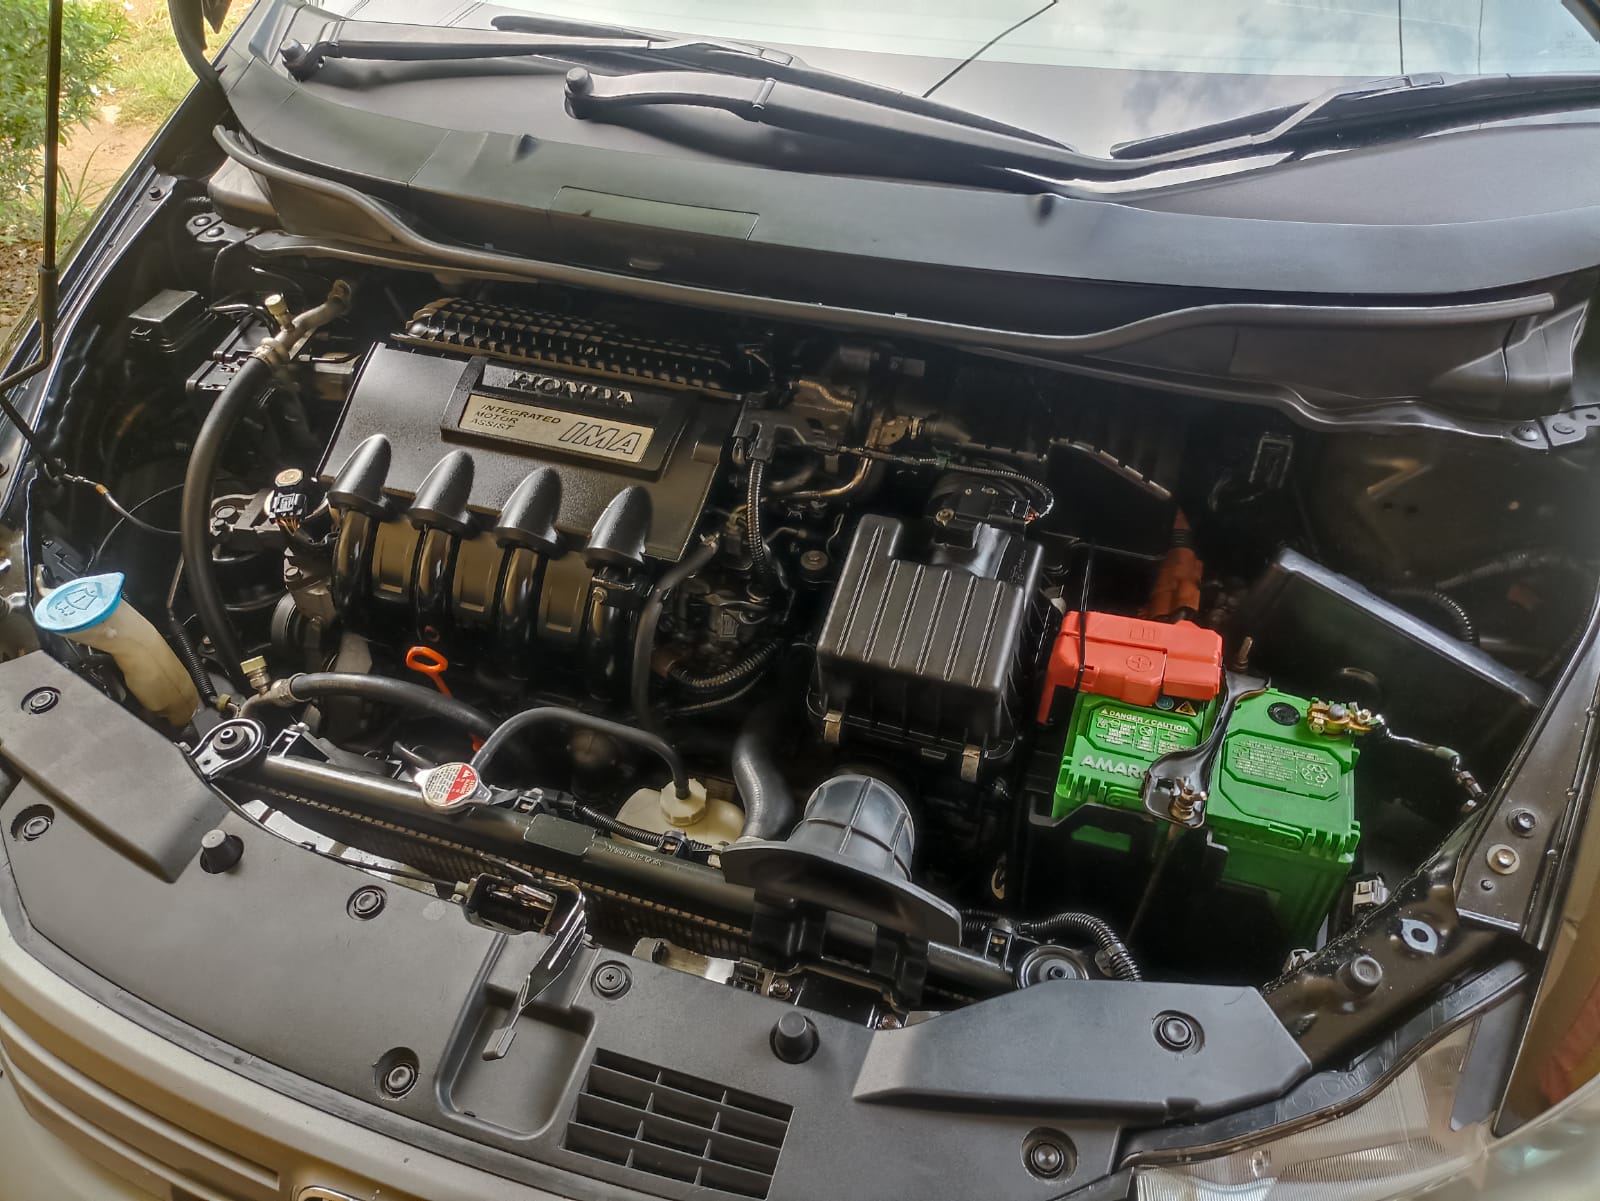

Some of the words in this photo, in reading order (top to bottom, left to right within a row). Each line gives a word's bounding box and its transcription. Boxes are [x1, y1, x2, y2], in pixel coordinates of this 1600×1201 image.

[508, 371, 633, 408] HONDA
[469, 417, 516, 431] ASSIST
[474, 411, 519, 424] MOTOR
[480, 403, 561, 425] INTEGRATED
[558, 421, 642, 455] IMA
[1109, 709, 1144, 723] DANGER
[1150, 719, 1190, 734] CAUTION
